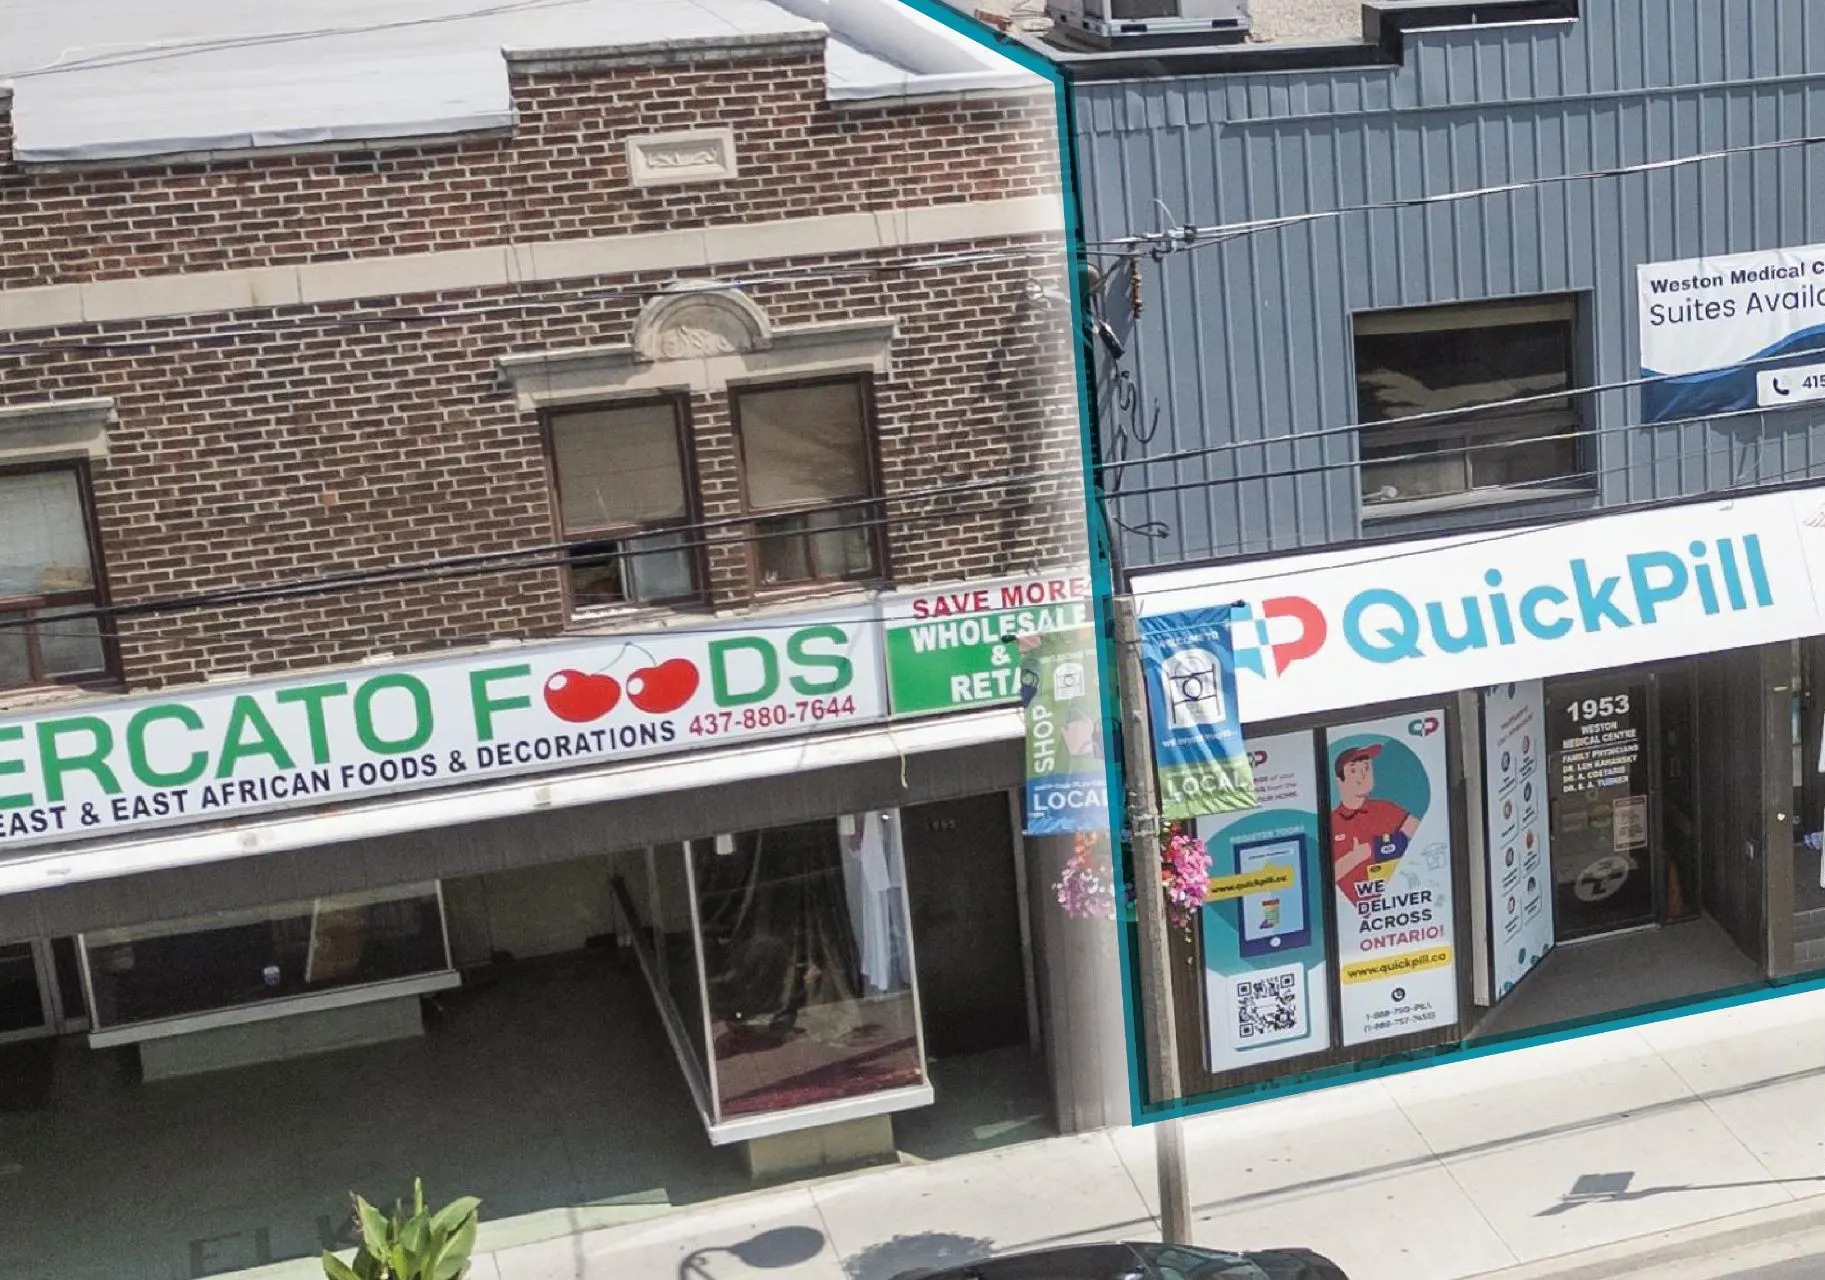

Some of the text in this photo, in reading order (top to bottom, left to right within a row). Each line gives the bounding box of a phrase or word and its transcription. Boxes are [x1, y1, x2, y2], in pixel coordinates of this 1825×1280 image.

[1650, 274, 1724, 295] Weston
[1730, 262, 1806, 286] Medical
[1650, 297, 1736, 326] Suites
[913, 576, 1087, 620] SAVE MORE
[1342, 533, 1774, 664] QuickPill
[910, 603, 1087, 654] WHOLESALE
[990, 644, 1012, 667] &
[1567, 694, 1631, 722] 1953
[1032, 704, 1055, 774] SHOP
[80, 801, 100, 826] &
[111, 789, 189, 821] EAST
[201, 768, 331, 810] AFRICAN
[341, 753, 437, 788] FOODS
[448, 749, 468, 774] &
[477, 720, 676, 769] DECORATIONS
[688, 694, 856, 737] 437-880-7644
[1166, 773, 1249, 803] LOCAL
[1356, 879, 1386, 896] WE
[1358, 890, 1432, 915] DELIVER
[1359, 908, 1433, 934] ACROSS
[1359, 925, 1445, 952] ONTARIO!
